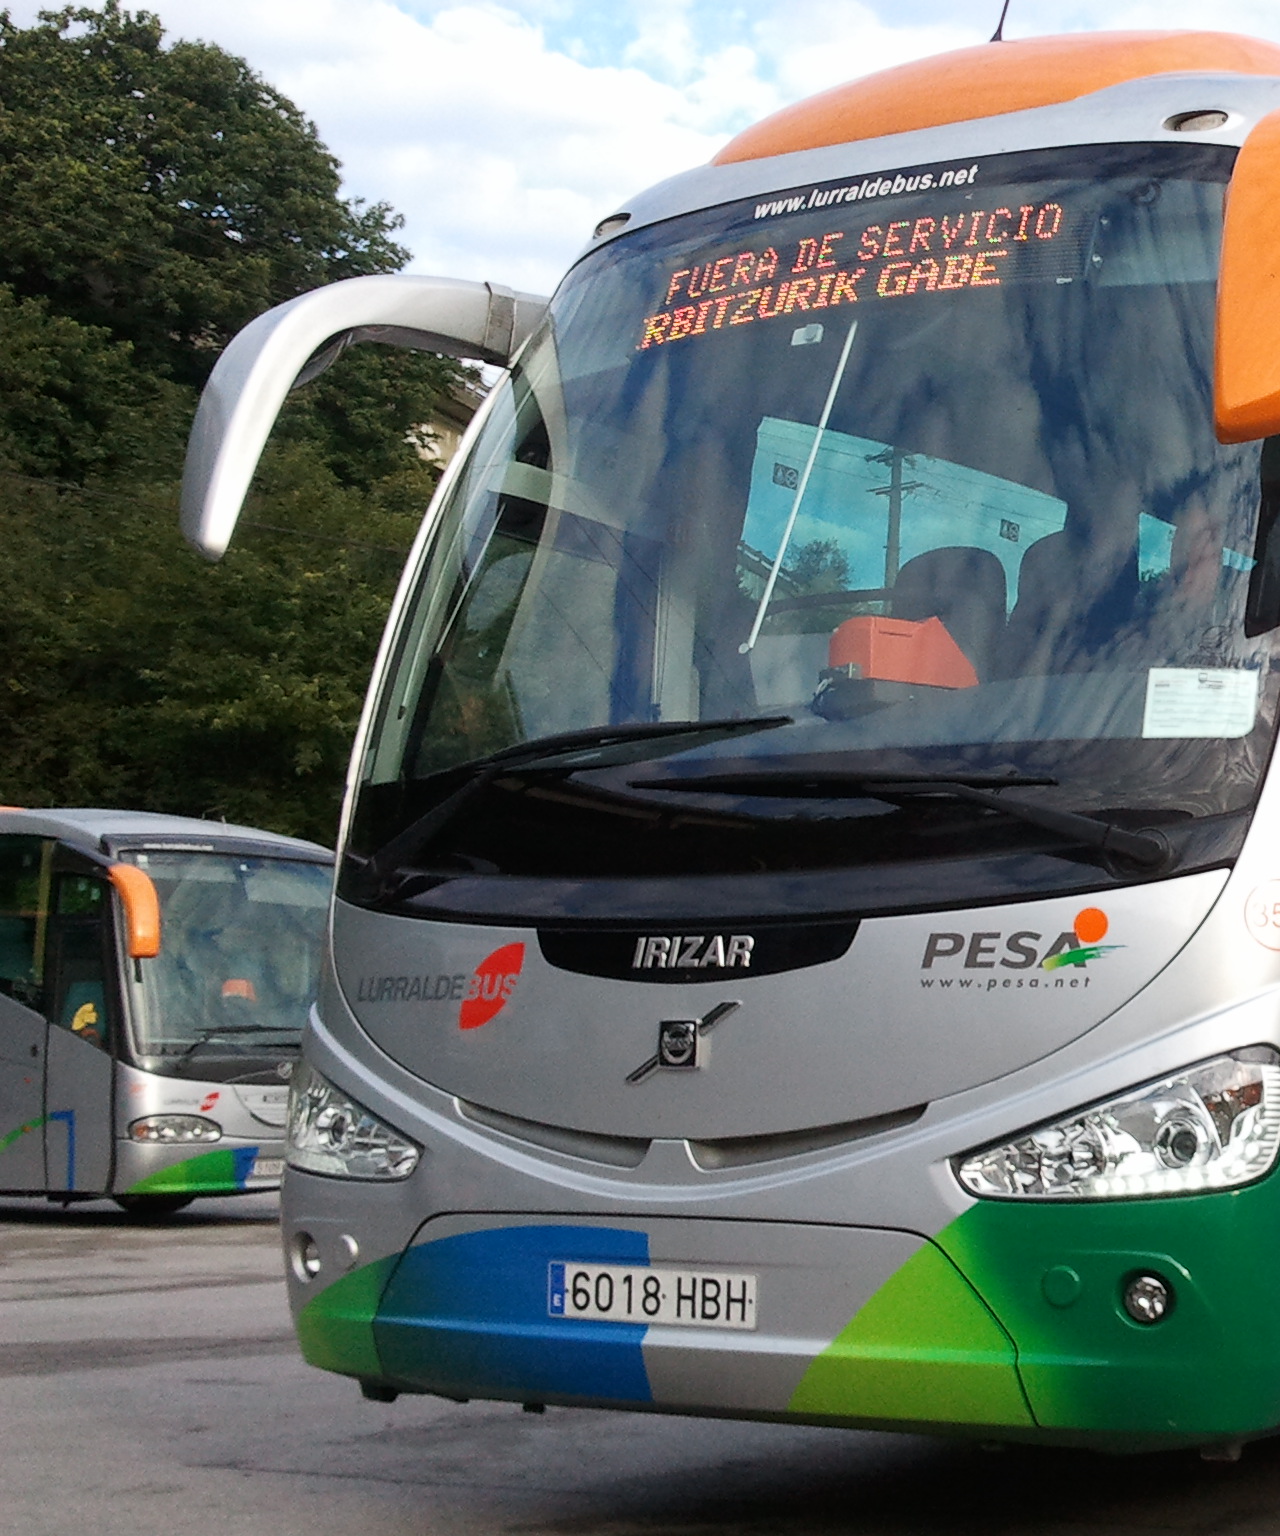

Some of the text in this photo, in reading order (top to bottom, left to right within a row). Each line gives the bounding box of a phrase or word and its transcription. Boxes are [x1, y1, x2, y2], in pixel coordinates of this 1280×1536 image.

[753, 164, 979, 220] www.lurraldebus.net
[665, 203, 1063, 305] FUERA DE SERVICIO
[636, 250, 1008, 349] RBITZURIK GABE
[632, 934, 755, 969] IRIZAR
[921, 931, 1088, 970] PESA
[921, 975, 1091, 992] www.pesa.net
[571, 1271, 661, 1317] 6018
[675, 1276, 747, 1322] HBH
